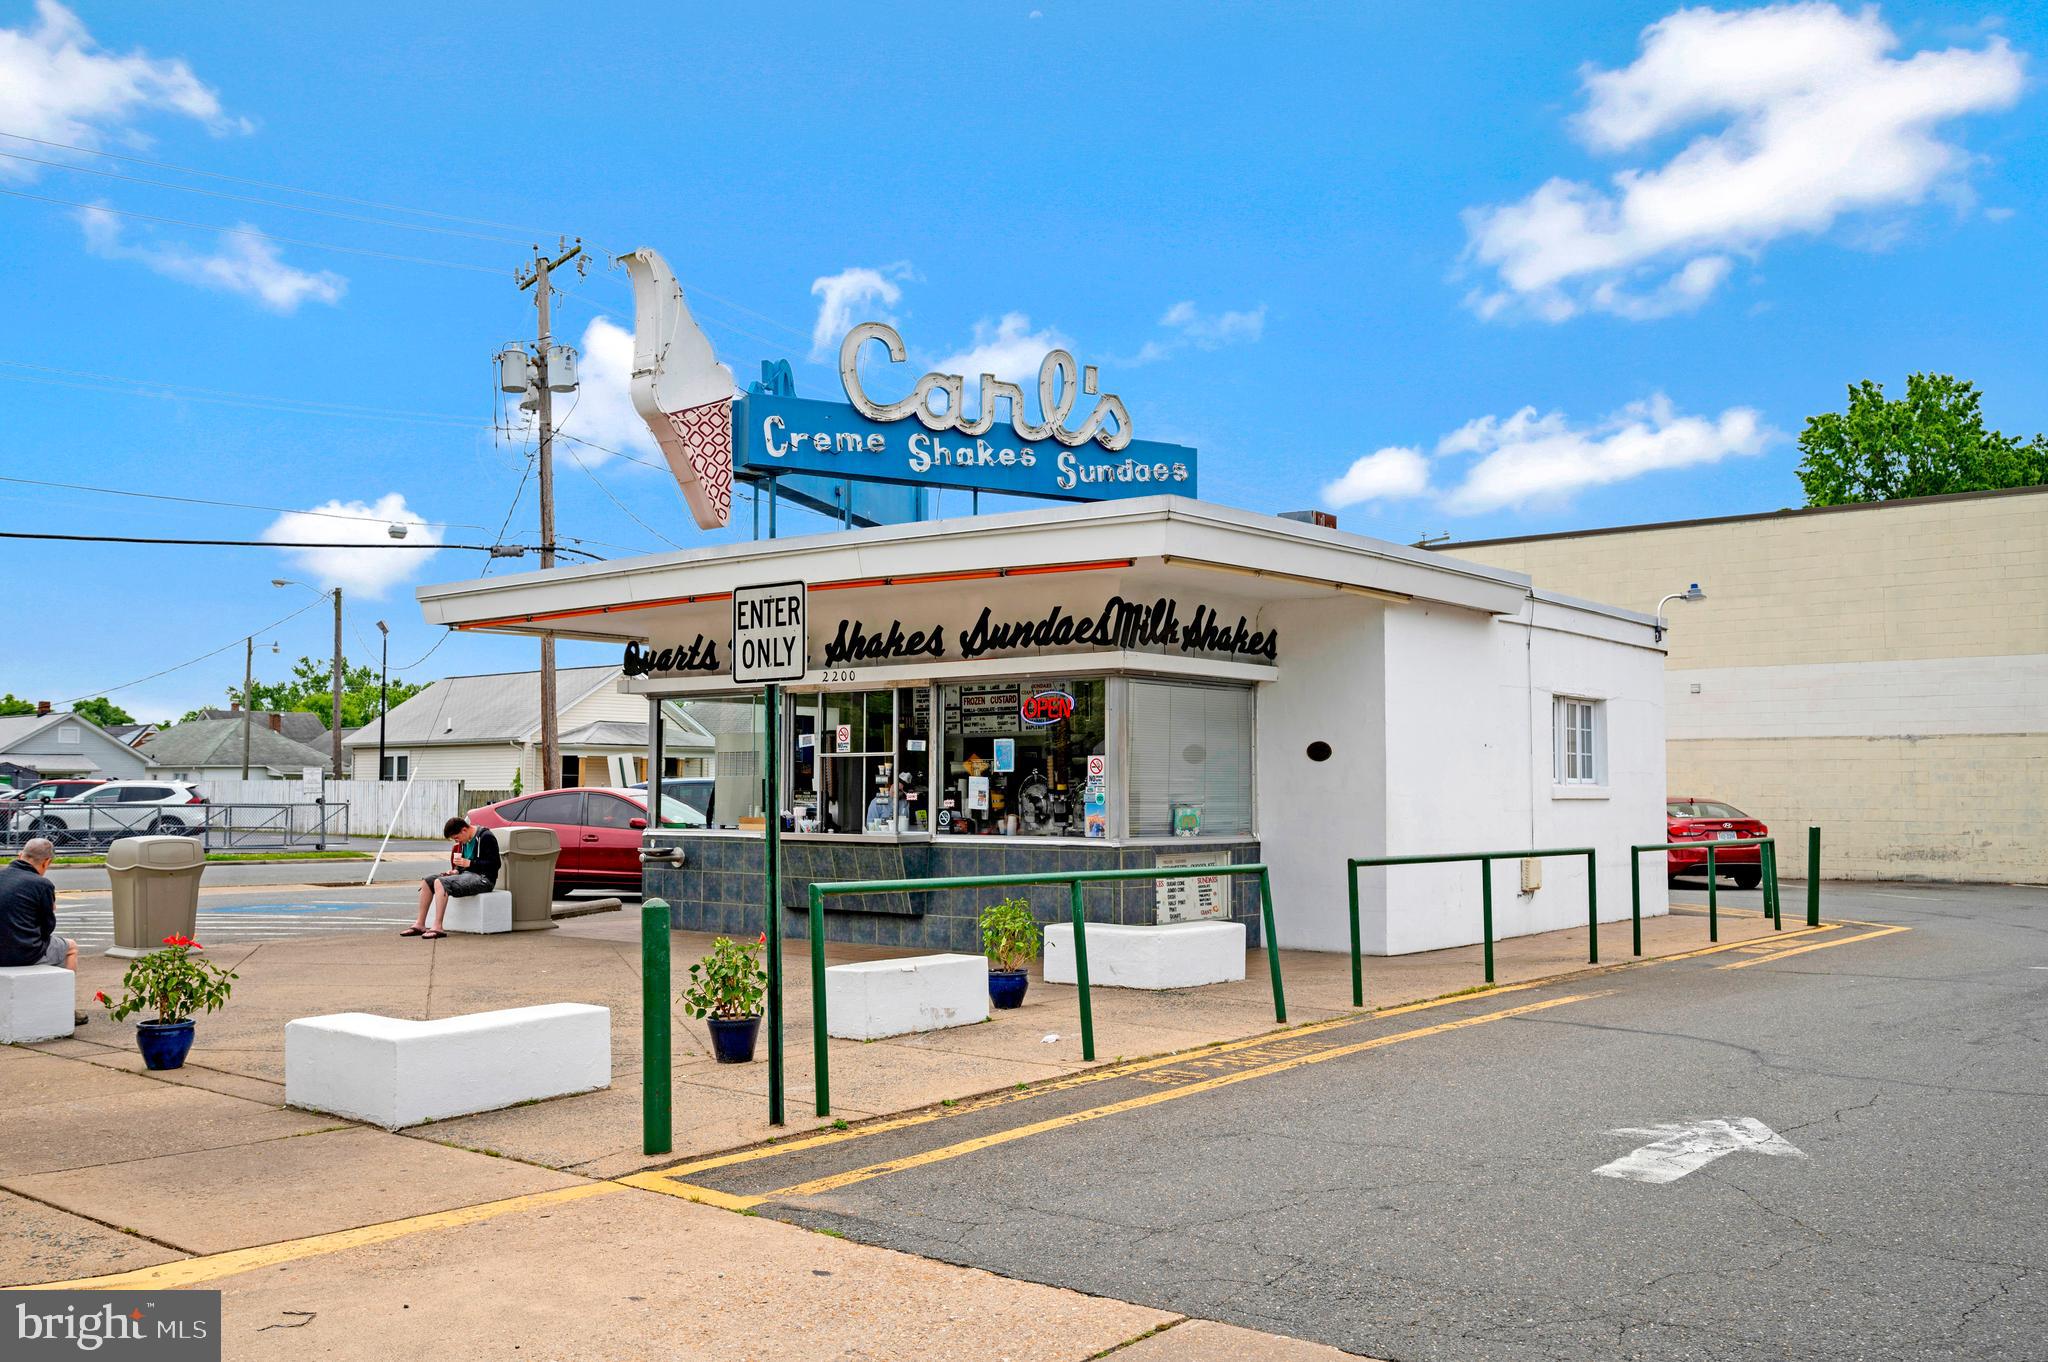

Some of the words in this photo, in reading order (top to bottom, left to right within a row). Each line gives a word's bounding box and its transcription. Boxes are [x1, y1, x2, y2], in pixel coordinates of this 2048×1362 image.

[840, 321, 1133, 451] Carl's
[764, 414, 887, 458] Creme
[908, 433, 1038, 473] Shakes
[1057, 451, 1190, 490] Sundaes
[737, 596, 801, 630] ENTER
[1105, 596, 1180, 649] Milk
[1181, 604, 1279, 660] Shakes
[622, 633, 720, 677] Quarts
[824, 619, 946, 668] Shakes
[960, 606, 1113, 659] Sundaes
[742, 636, 797, 669] ONLY
[822, 671, 856, 683] 2200
[963, 696, 986, 706] FROZEN
[990, 695, 1017, 705] CUSTARD
[1024, 697, 1071, 719] OPEN
